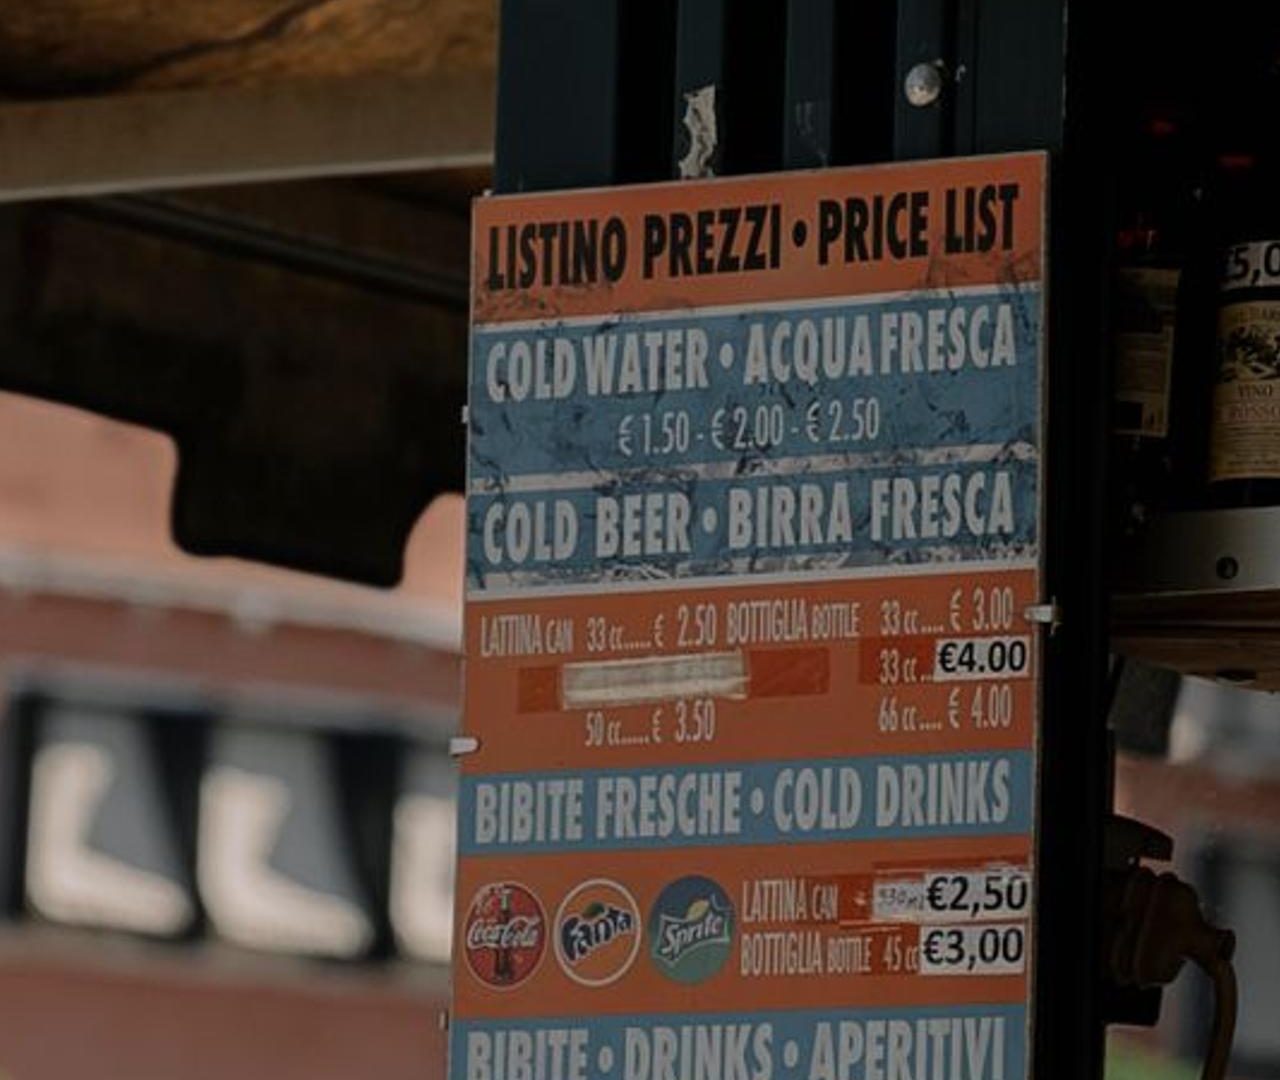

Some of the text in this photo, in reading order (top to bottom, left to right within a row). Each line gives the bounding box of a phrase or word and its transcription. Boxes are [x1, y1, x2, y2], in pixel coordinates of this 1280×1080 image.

[488, 184, 1019, 291] LISTINO PREZZI PRICE LIST
[485, 303, 1017, 404] COLD WATER ACQUA FRESCA
[619, 414, 634, 457] €
[643, 410, 690, 456] 1.50
[711, 408, 726, 450] €
[733, 403, 784, 450] 2.00
[806, 400, 821, 443] €
[828, 396, 880, 442] 2.50
[483, 471, 1015, 566] COLD BEER BIRRA FRESCA
[480, 614, 544, 657] LATTINA
[545, 618, 574, 654] CAN
[586, 616, 606, 652] 33
[677, 602, 717, 648] 2.50
[726, 598, 809, 644] BOTTIGLIA
[811, 602, 861, 641] BOTTLE
[880, 599, 901, 636] 33
[972, 585, 1014, 632] 3.00
[879, 647, 900, 685] 33
[938, 640, 1026, 673] €4.00
[584, 710, 604, 747] 50
[675, 699, 716, 743] 3.50
[878, 695, 899, 732] 66
[970, 682, 1012, 729] 4.00
[475, 758, 1011, 845] BIBITE FRESCHE COLD DRINKS
[742, 878, 839, 923] LATTINA CAN
[927, 875, 1027, 918] €2,50
[562, 906, 633, 964] Fanta
[660, 910, 723, 960] Sprite
[740, 931, 822, 977] BOTTIGLIA
[826, 935, 873, 973] BOTTLE
[880, 934, 903, 972] 45
[923, 928, 1024, 971] €3,00
[467, 1016, 1005, 1080] BIBITE DRINKS APERITIVI
